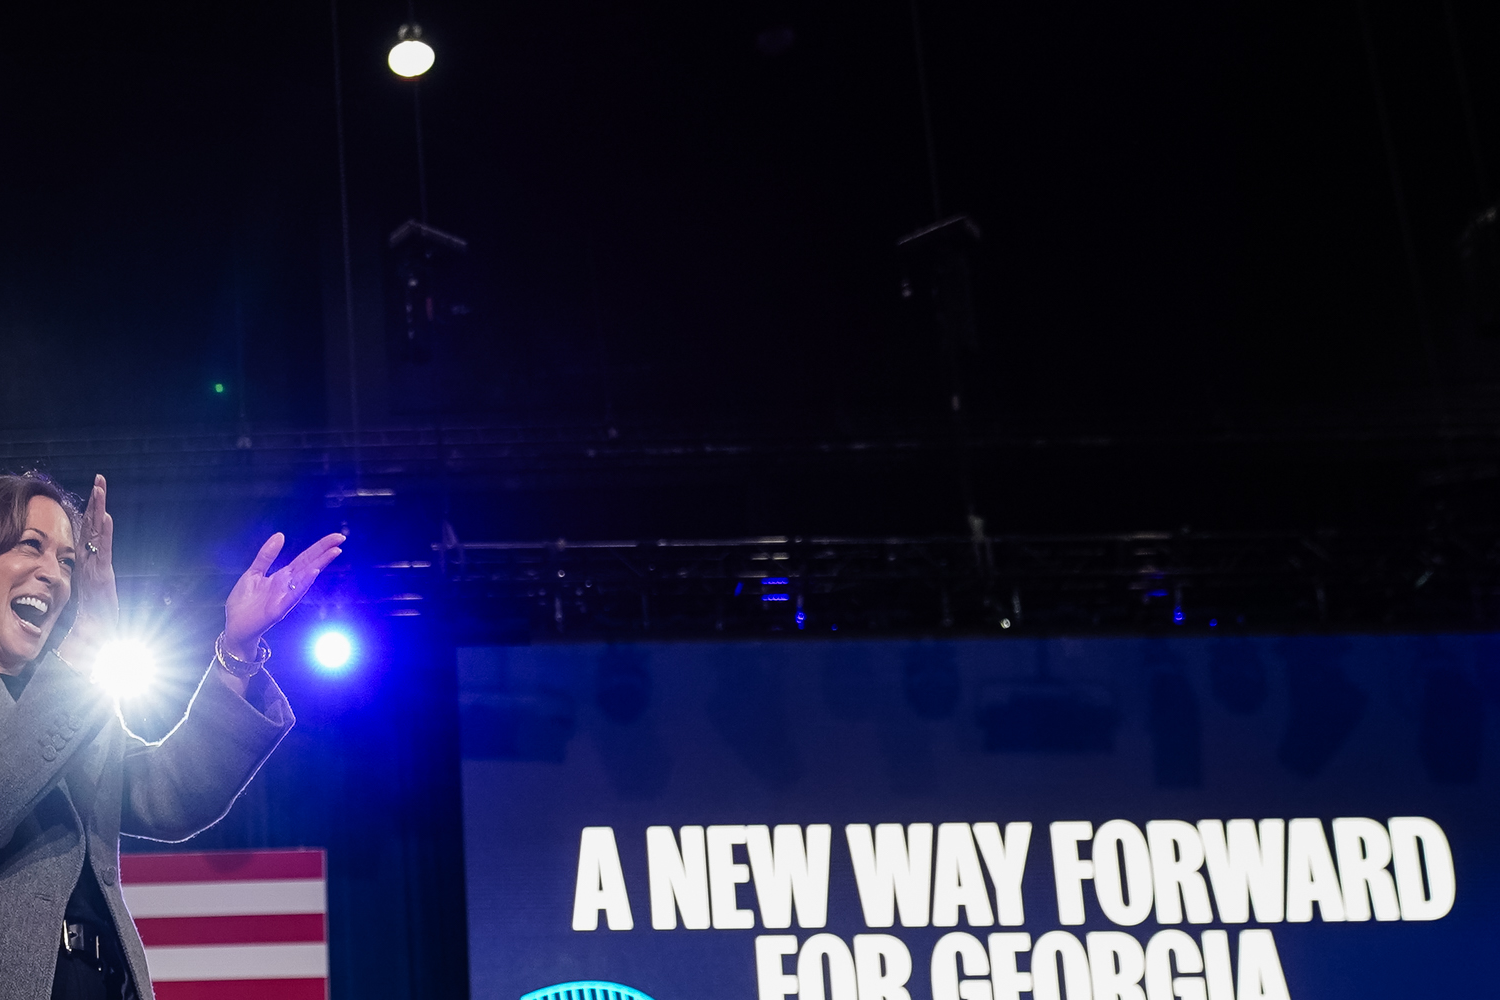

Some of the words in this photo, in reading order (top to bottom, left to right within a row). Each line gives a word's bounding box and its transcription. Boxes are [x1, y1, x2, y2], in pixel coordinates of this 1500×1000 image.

[571, 826, 634, 931] A
[646, 824, 832, 930] NEW
[846, 822, 1032, 928] WAY
[1049, 816, 1457, 927] FORWARD
